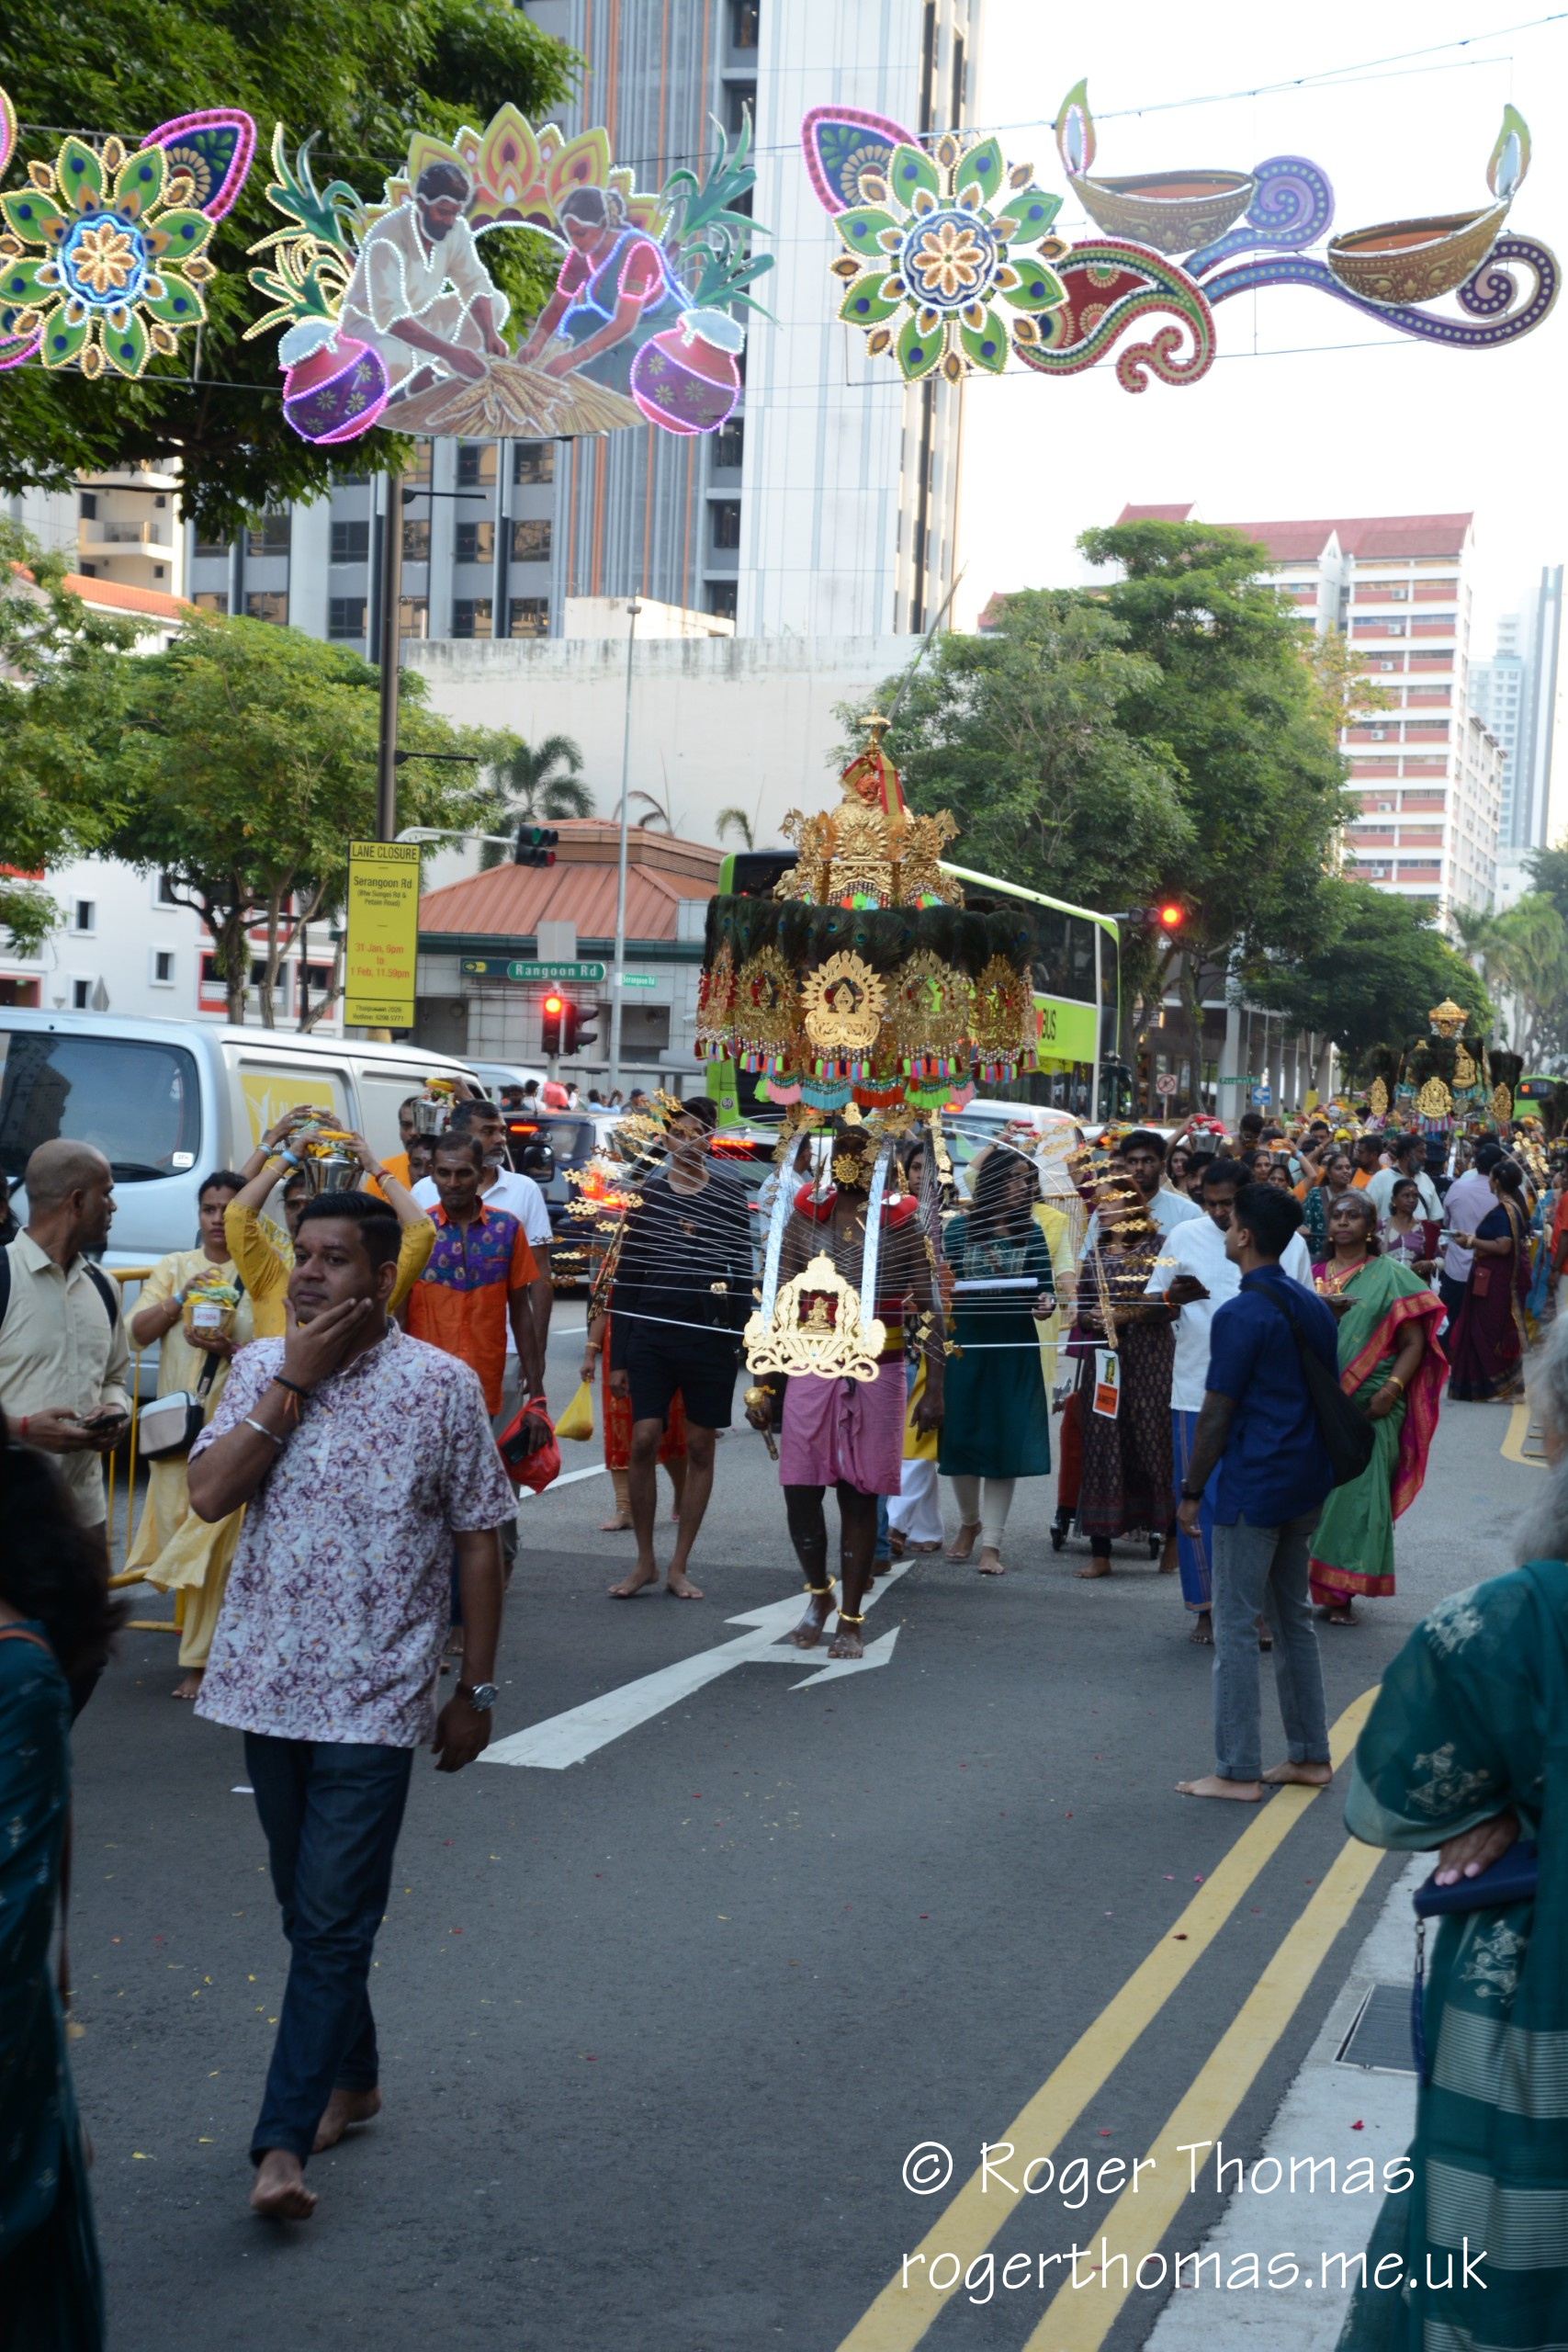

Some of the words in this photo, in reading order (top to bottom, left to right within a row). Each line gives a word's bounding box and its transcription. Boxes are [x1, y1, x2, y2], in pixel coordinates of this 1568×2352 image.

[353, 844, 375, 858] LANE
[378, 846, 417, 860] CLOSURE
[354, 876, 399, 889] Serangoon
[401, 878, 412, 888] Rd
[372, 890, 391, 899] Sungei
[355, 942, 365, 952] 31
[386, 944, 404, 955] 6pm
[377, 956, 384, 965] to
[357, 967, 374, 978] Feb,
[377, 967, 410, 979] 11.59pm
[515, 964, 575, 978] Rangoon
[581, 965, 596, 977] Rd
[623, 975, 648, 985] Serangoon
[649, 976, 655, 985] Rd
[1042, 1008, 1056, 1040] BUS
